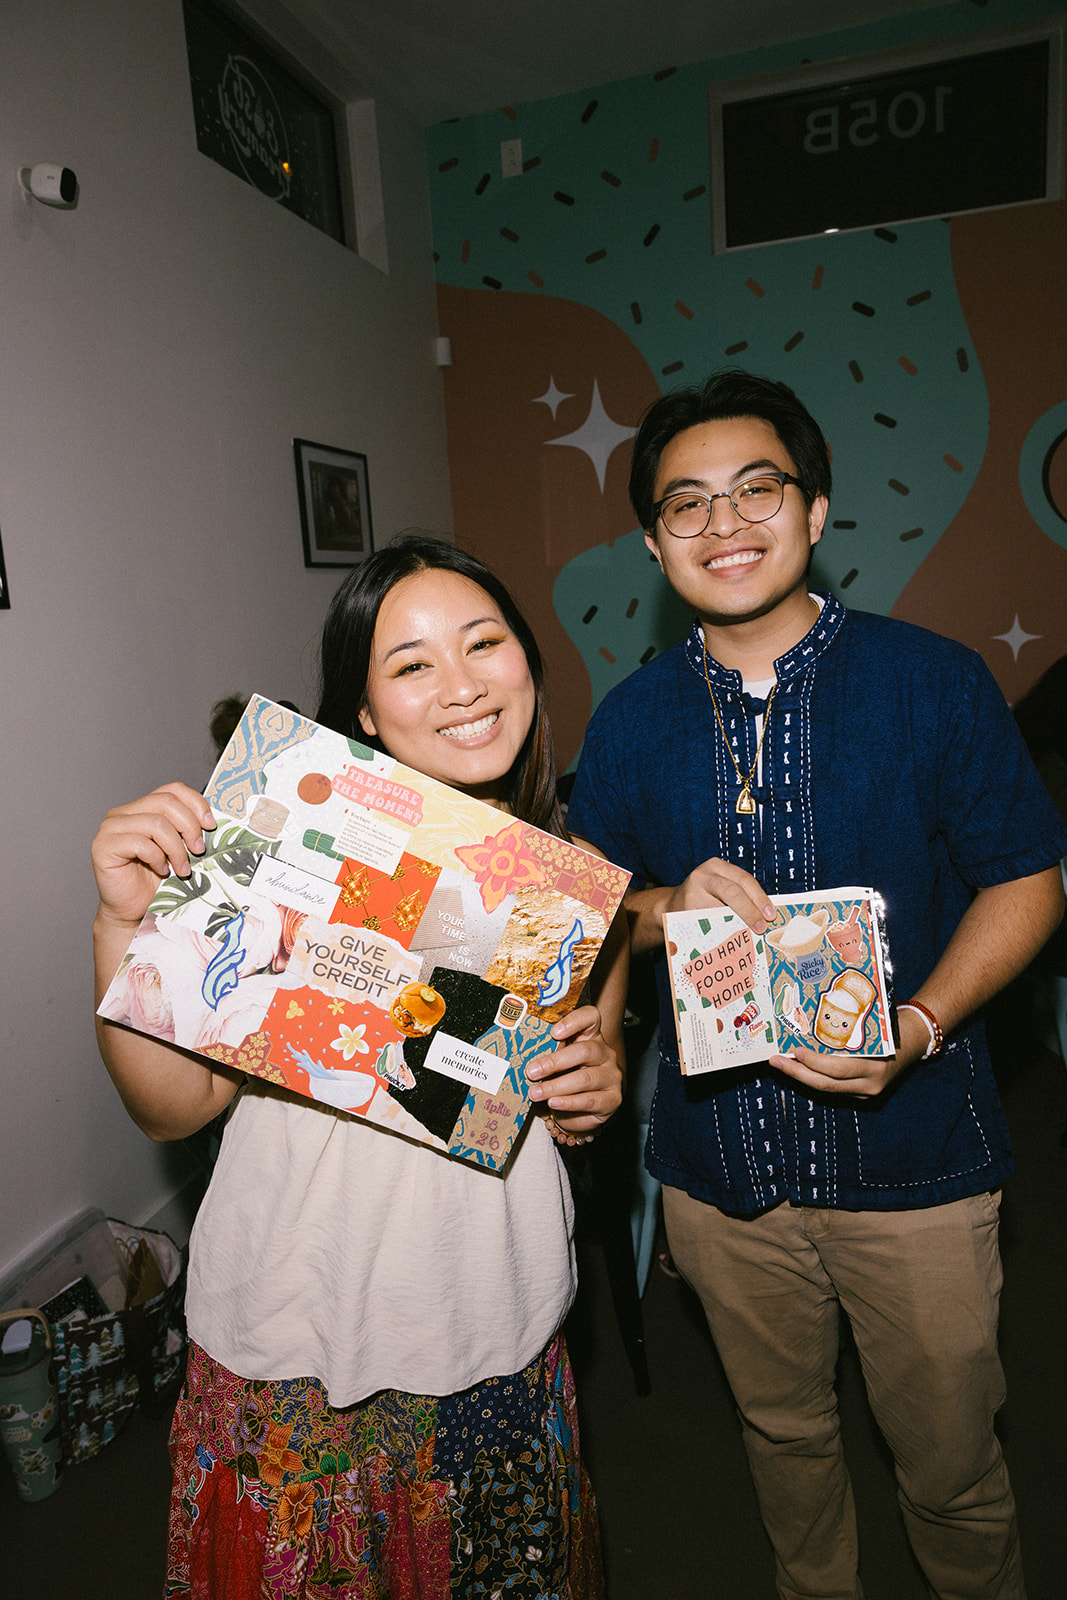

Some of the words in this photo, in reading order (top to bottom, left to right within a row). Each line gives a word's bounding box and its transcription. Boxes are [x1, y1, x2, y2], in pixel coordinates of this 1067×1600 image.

[349, 769, 419, 806] TREASURE
[333, 778, 360, 800] THE
[362, 793, 421, 825] MOMENT
[265, 872, 326, 905] abundance
[437, 910, 465, 928] YOUR
[441, 924, 467, 942] TIME
[340, 935, 387, 962] GIVE
[458, 945, 470, 956] IS
[685, 953, 713, 977] YOU
[717, 930, 751, 959] HAVE
[305, 939, 411, 987] YOURSELF
[448, 952, 473, 968] NOW
[801, 957, 825, 971] Sticky
[313, 962, 388, 998] CREDIT
[696, 965, 734, 995] FOOD
[738, 952, 752, 971] AT
[797, 967, 820, 980] Rice
[712, 976, 752, 1008] HOME
[780, 1015, 796, 1029] PHUCK
[441, 1055, 489, 1081] memories
[454, 1048, 485, 1067] create
[384, 1073, 401, 1087] PHUCK
[486, 1117, 498, 1132] 18
